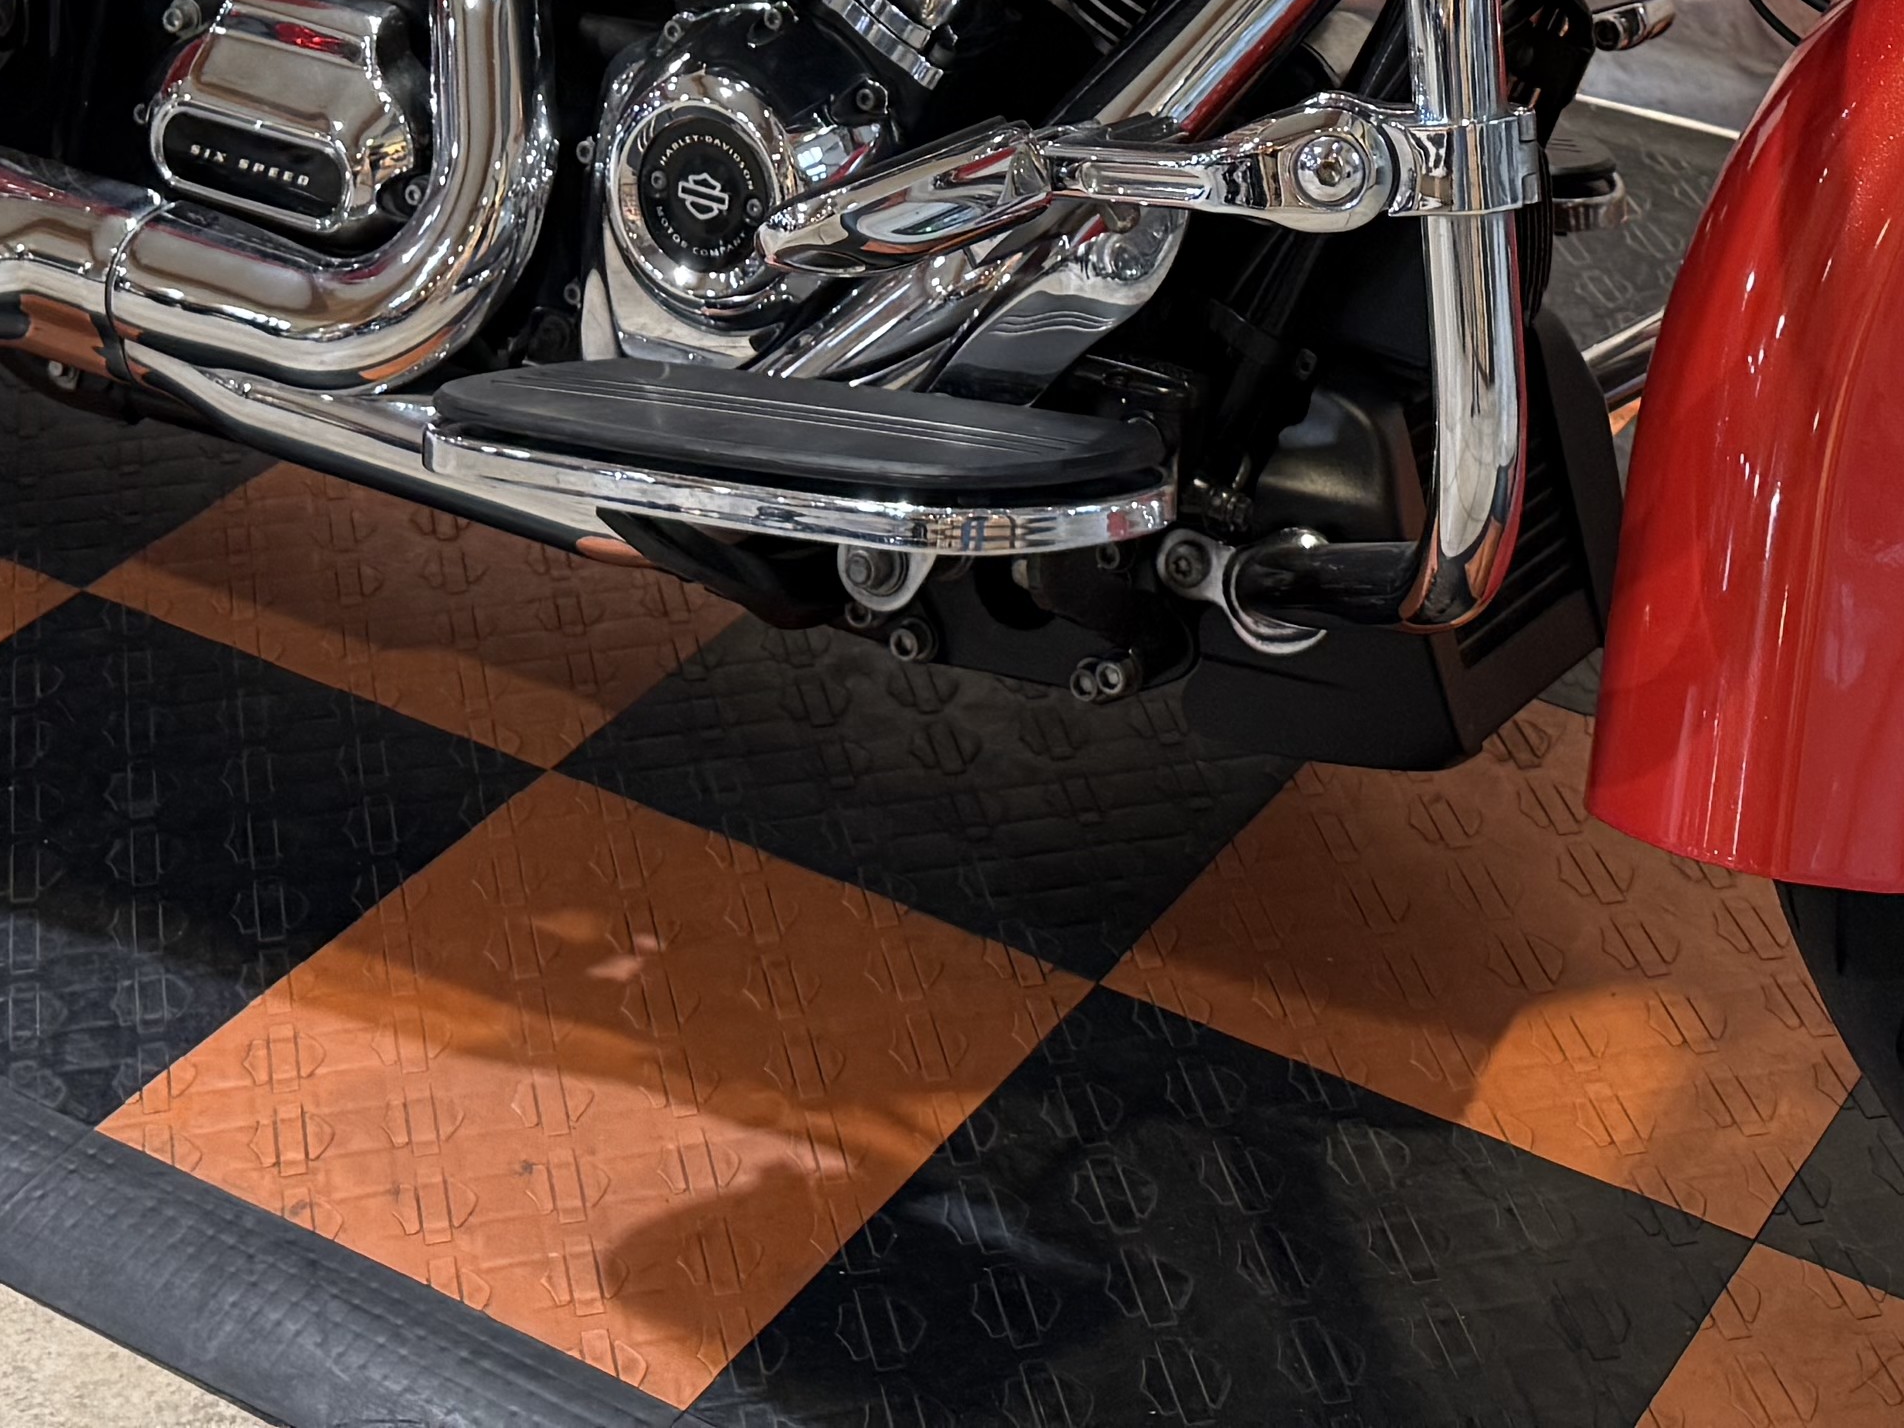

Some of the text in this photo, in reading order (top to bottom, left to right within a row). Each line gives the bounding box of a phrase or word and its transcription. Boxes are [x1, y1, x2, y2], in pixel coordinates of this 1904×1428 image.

[190, 144, 310, 186] SIX SPEED
[659, 134, 755, 190] HARLEY-DAVIDSON
[656, 205, 746, 258] MOTOR COMPANY
